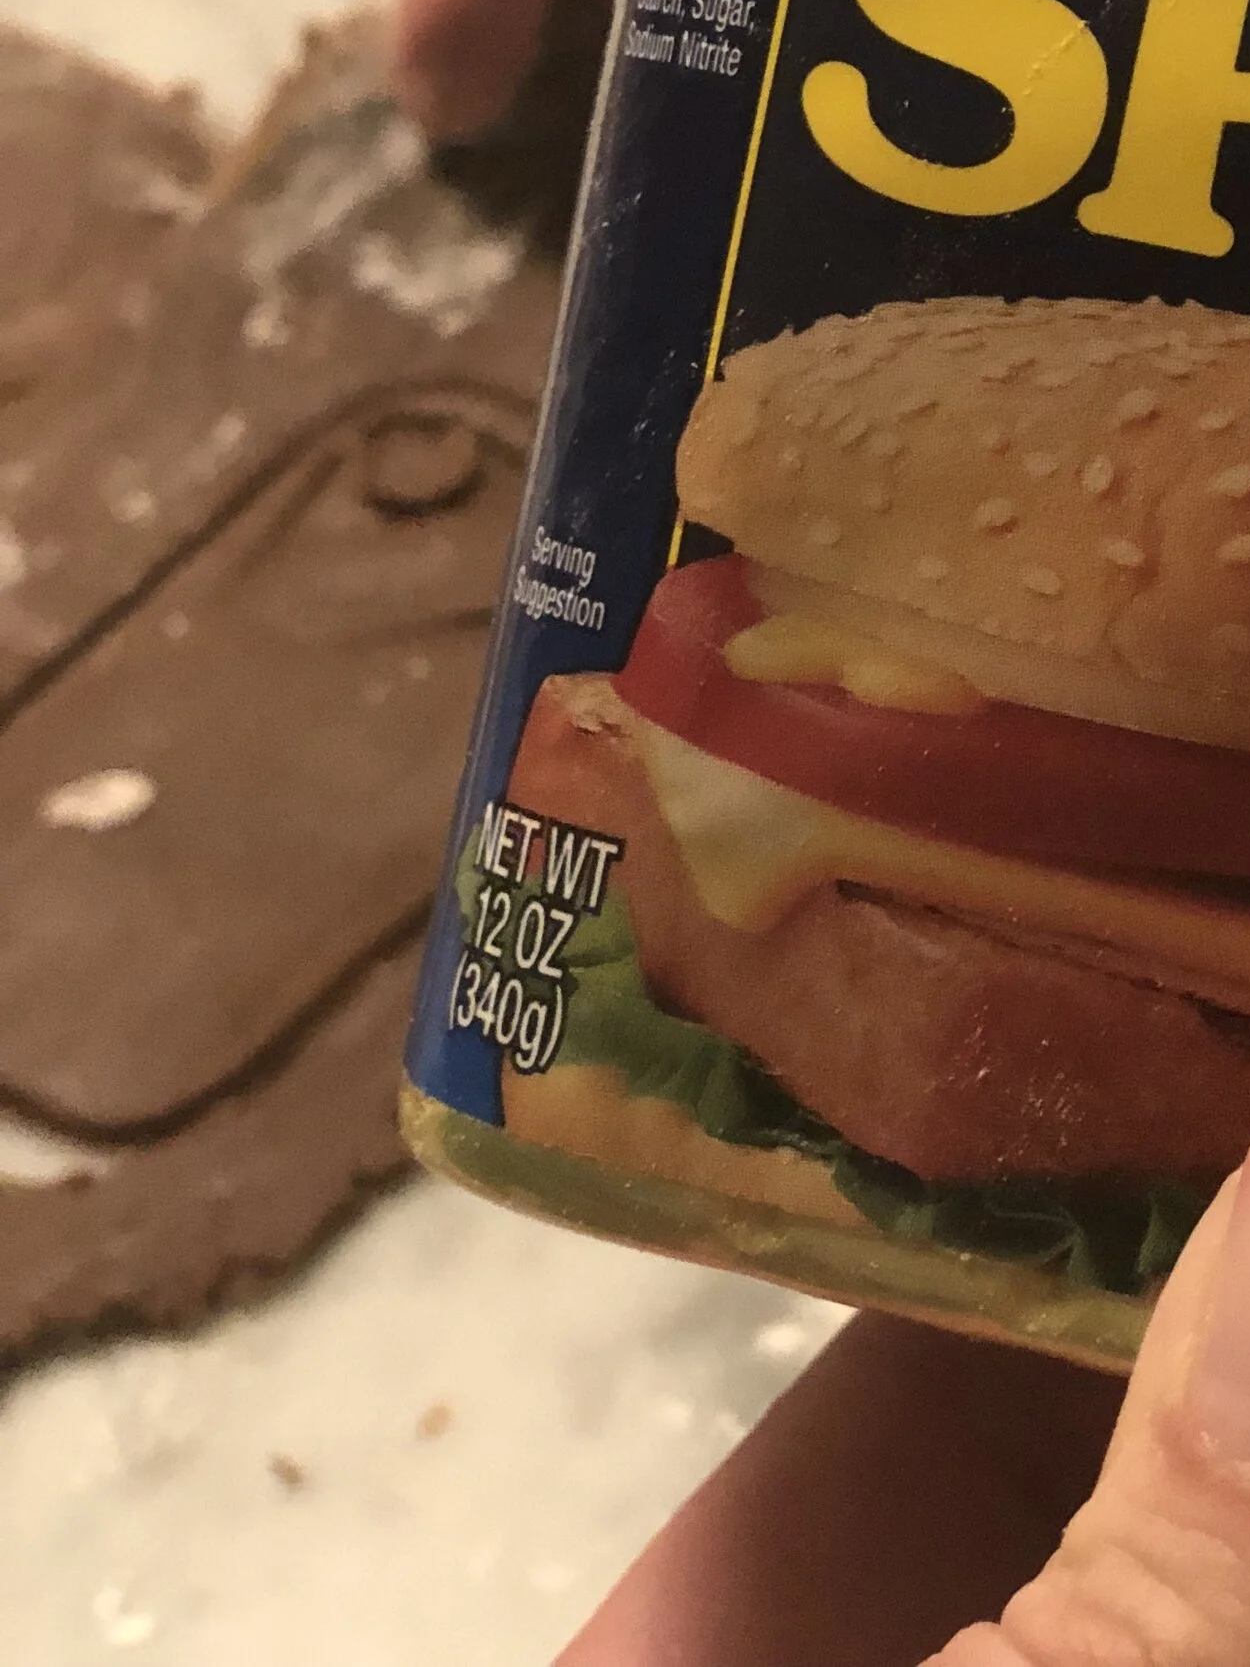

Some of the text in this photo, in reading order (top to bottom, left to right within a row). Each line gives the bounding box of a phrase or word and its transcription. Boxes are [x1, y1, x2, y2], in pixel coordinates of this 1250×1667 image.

[678, 30, 743, 77] Nitrite
[531, 525, 596, 587] Serving
[513, 564, 605, 630] Suggestion
[474, 801, 620, 908] NET WT
[473, 886, 577, 977] 12 OZ
[448, 959, 565, 1071] (340g)
